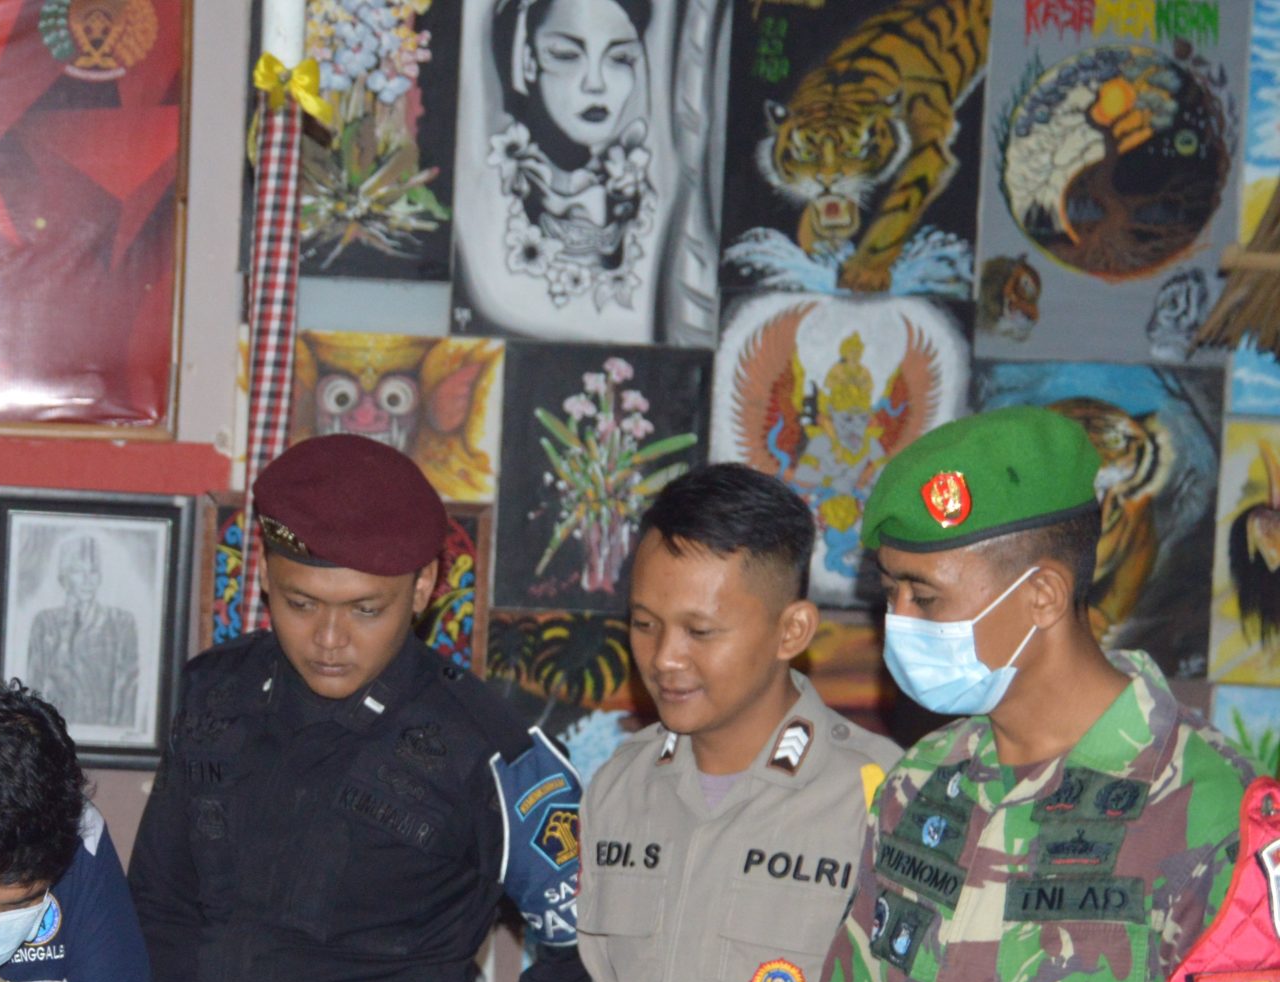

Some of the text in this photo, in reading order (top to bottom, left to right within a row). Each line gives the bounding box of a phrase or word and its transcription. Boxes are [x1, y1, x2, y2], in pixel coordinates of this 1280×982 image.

[643, 842, 662, 870] S
[743, 848, 853, 890] POLRI
[879, 844, 959, 898] PURNOMO
[1020, 886, 1128, 912] TNI AD
